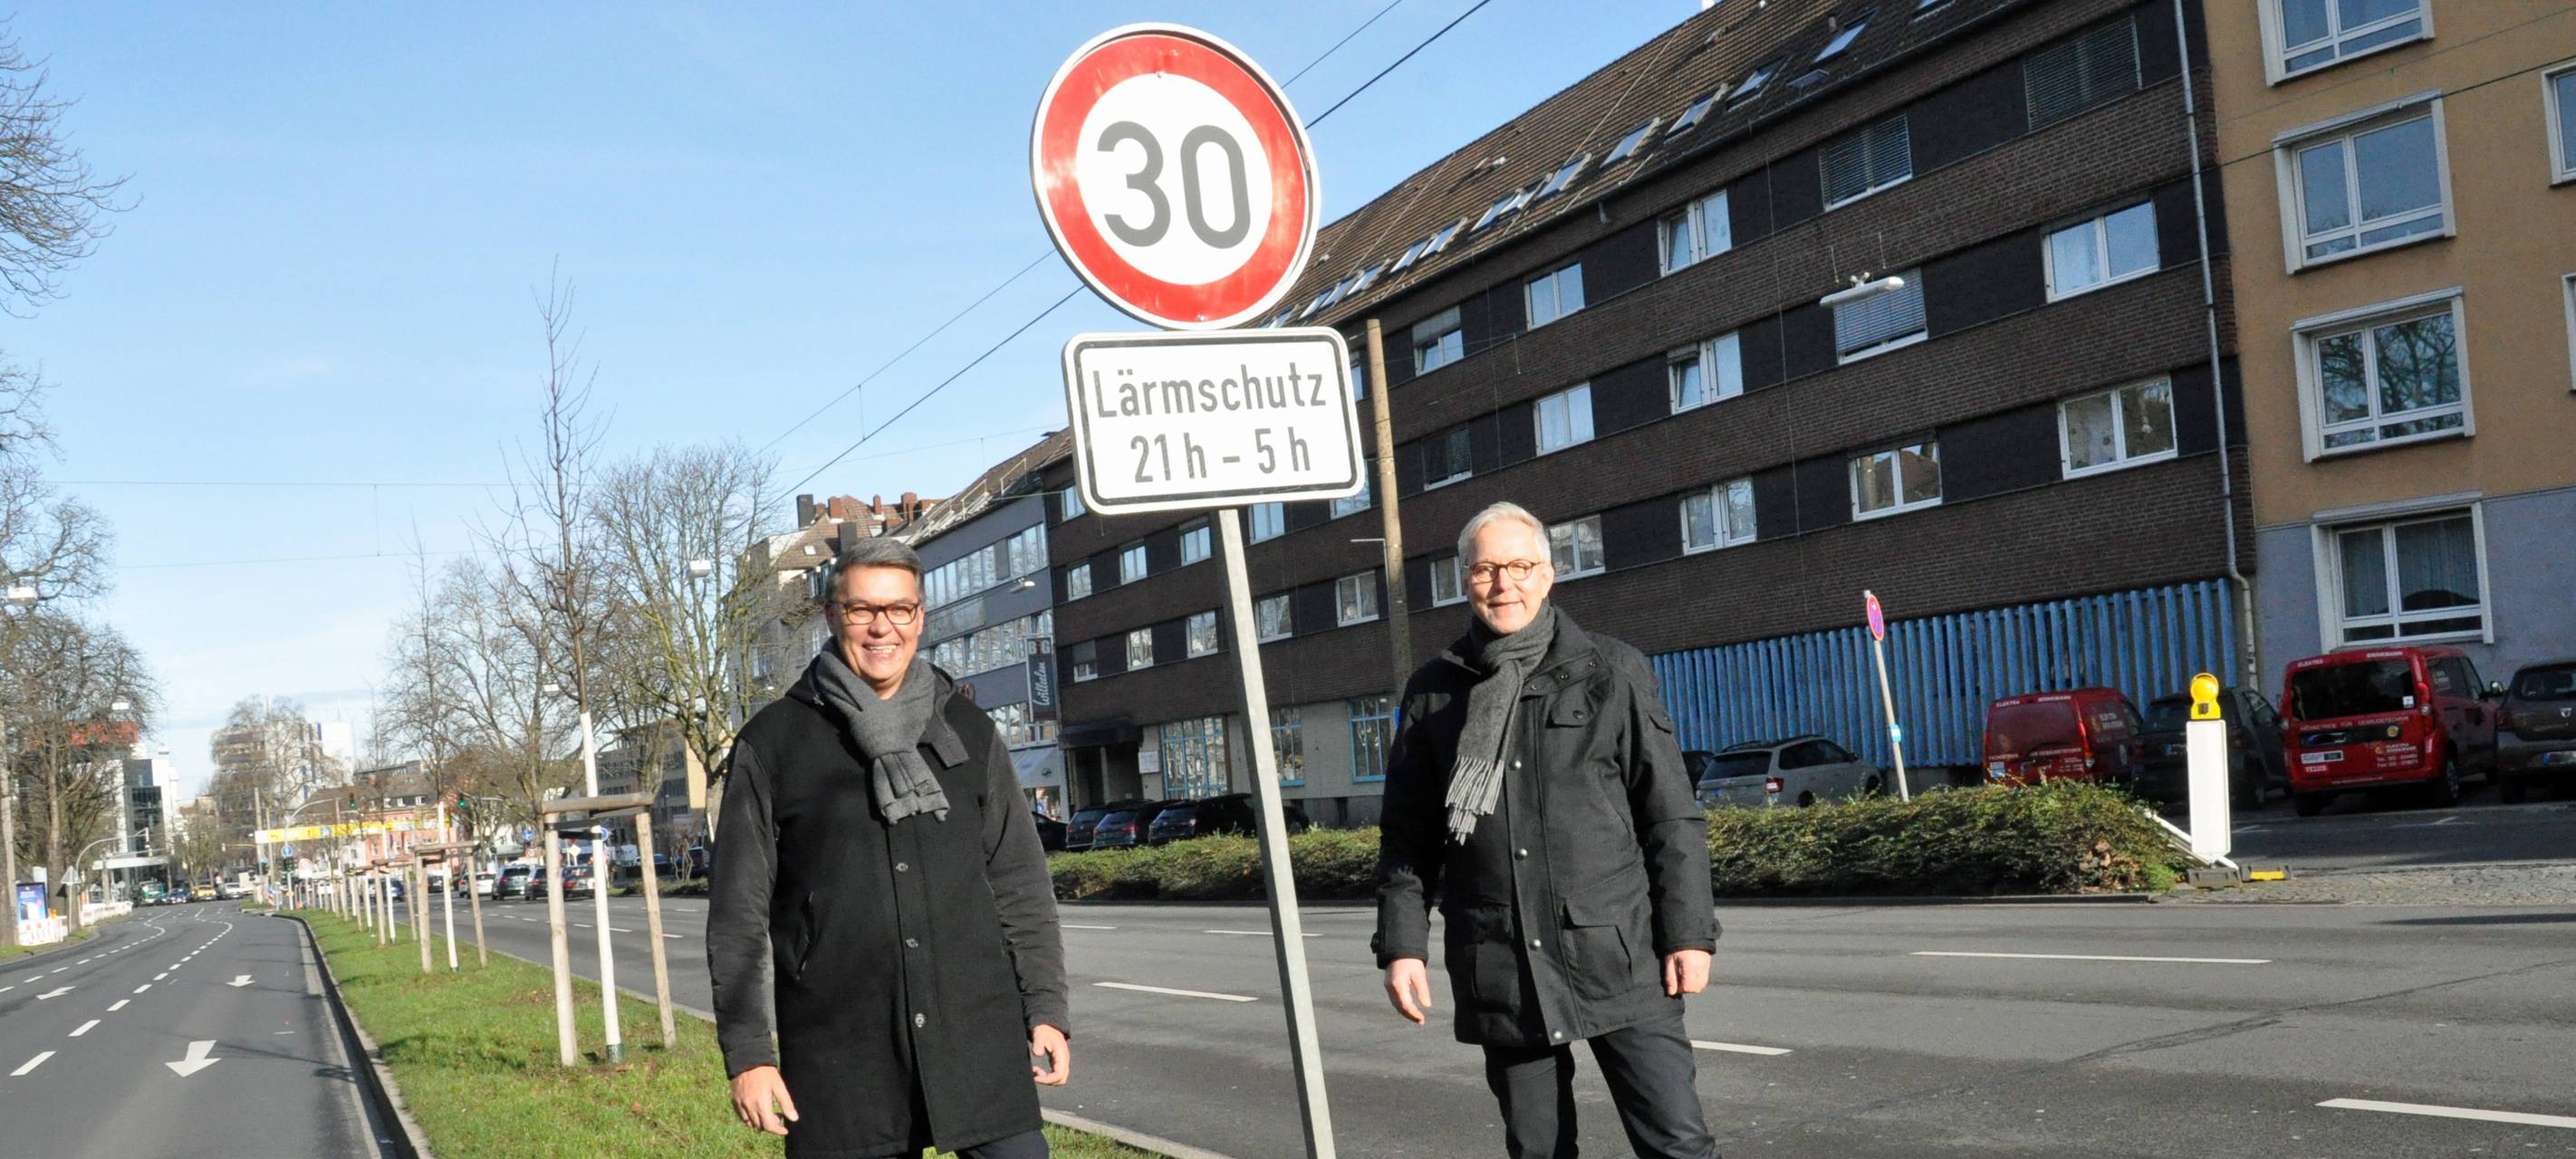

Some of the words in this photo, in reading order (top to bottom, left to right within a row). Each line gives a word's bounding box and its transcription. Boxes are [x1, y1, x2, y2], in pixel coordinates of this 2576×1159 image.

[1097, 120, 1251, 249] 30
[1092, 362, 1326, 417] Lärmschutz
[1130, 433, 1171, 483] 21
[1184, 432, 1207, 480] h
[1254, 428, 1276, 474] 5
[1288, 426, 1311, 472] h
